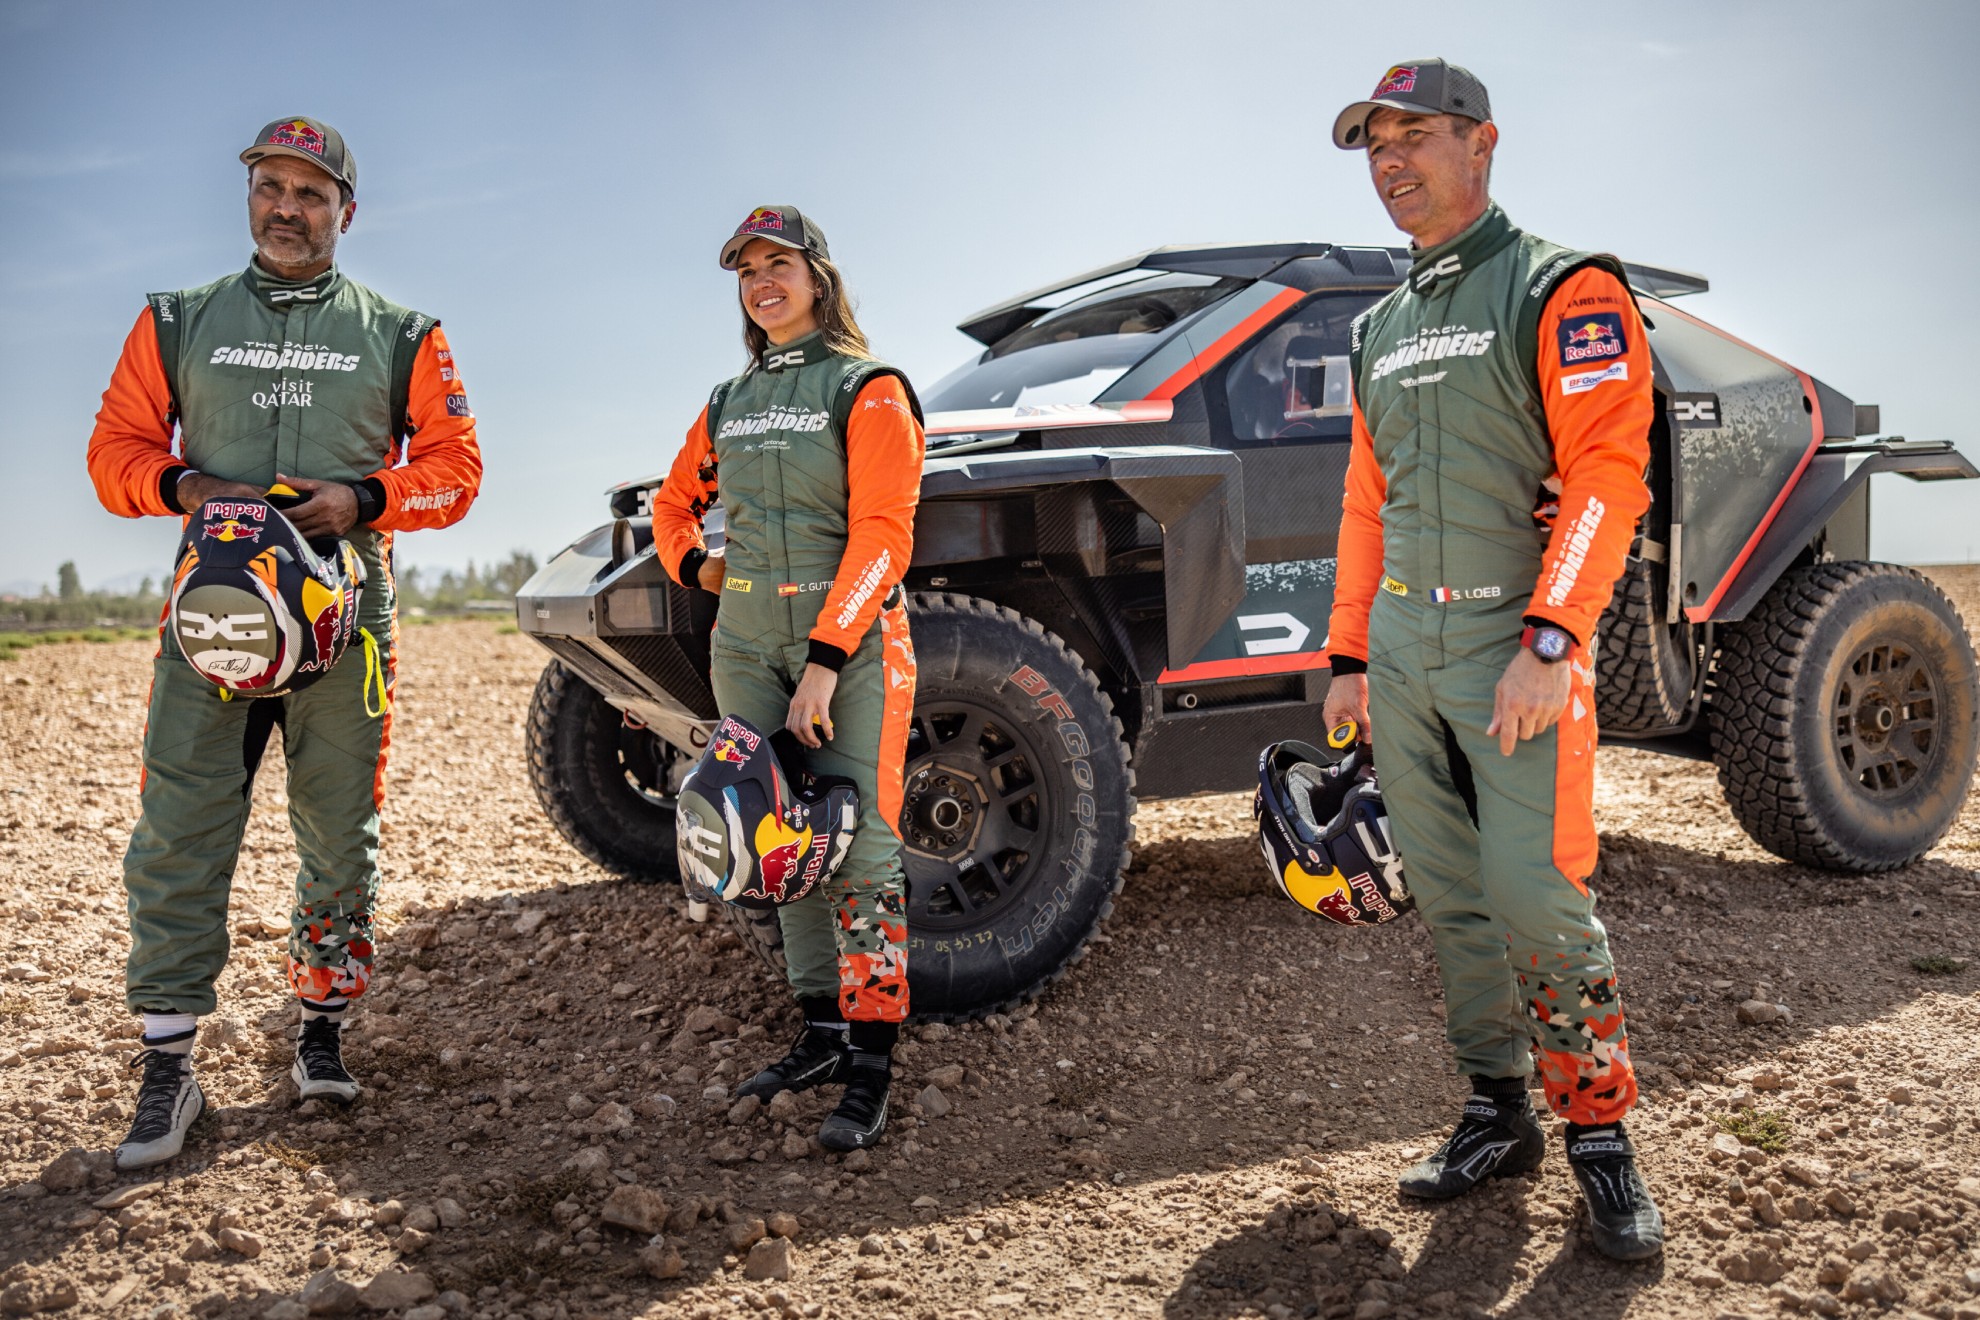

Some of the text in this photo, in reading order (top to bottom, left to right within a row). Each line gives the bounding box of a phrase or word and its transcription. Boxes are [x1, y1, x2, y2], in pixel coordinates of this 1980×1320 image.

[1383, 80, 1415, 94] Bull
[268, 134, 323, 155] Red Bull
[757, 221, 782, 230] Bull
[1530, 259, 1567, 298] Sabelt
[158, 295, 175, 323] Sabelt
[1421, 325, 1468, 335] DACIA
[244, 341, 330, 351] THE DACIA
[1371, 331, 1496, 381] SANDRIDERS
[1565, 339, 1621, 361] Red Bull
[210, 346, 360, 372] SANDRIDERS
[272, 377, 314, 393] visit
[252, 391, 312, 409] QATAR
[770, 405, 811, 413] DACIA
[718, 411, 830, 440] SANDRIDERS
[204, 503, 267, 521] Red Bull
[1559, 519, 1577, 560] DACIA
[728, 579, 748, 591] Sabelt
[808, 580, 834, 591] GUTIE
[837, 548, 890, 630] SANDRIDERS
[838, 561, 874, 607] THE DACIA
[1452, 586, 1501, 601] S. LOEB
[720, 716, 761, 752] Red Bull
[918, 770, 928, 780] 101
[787, 833, 830, 902] Red Bull
[1348, 871, 1383, 906] Bull
